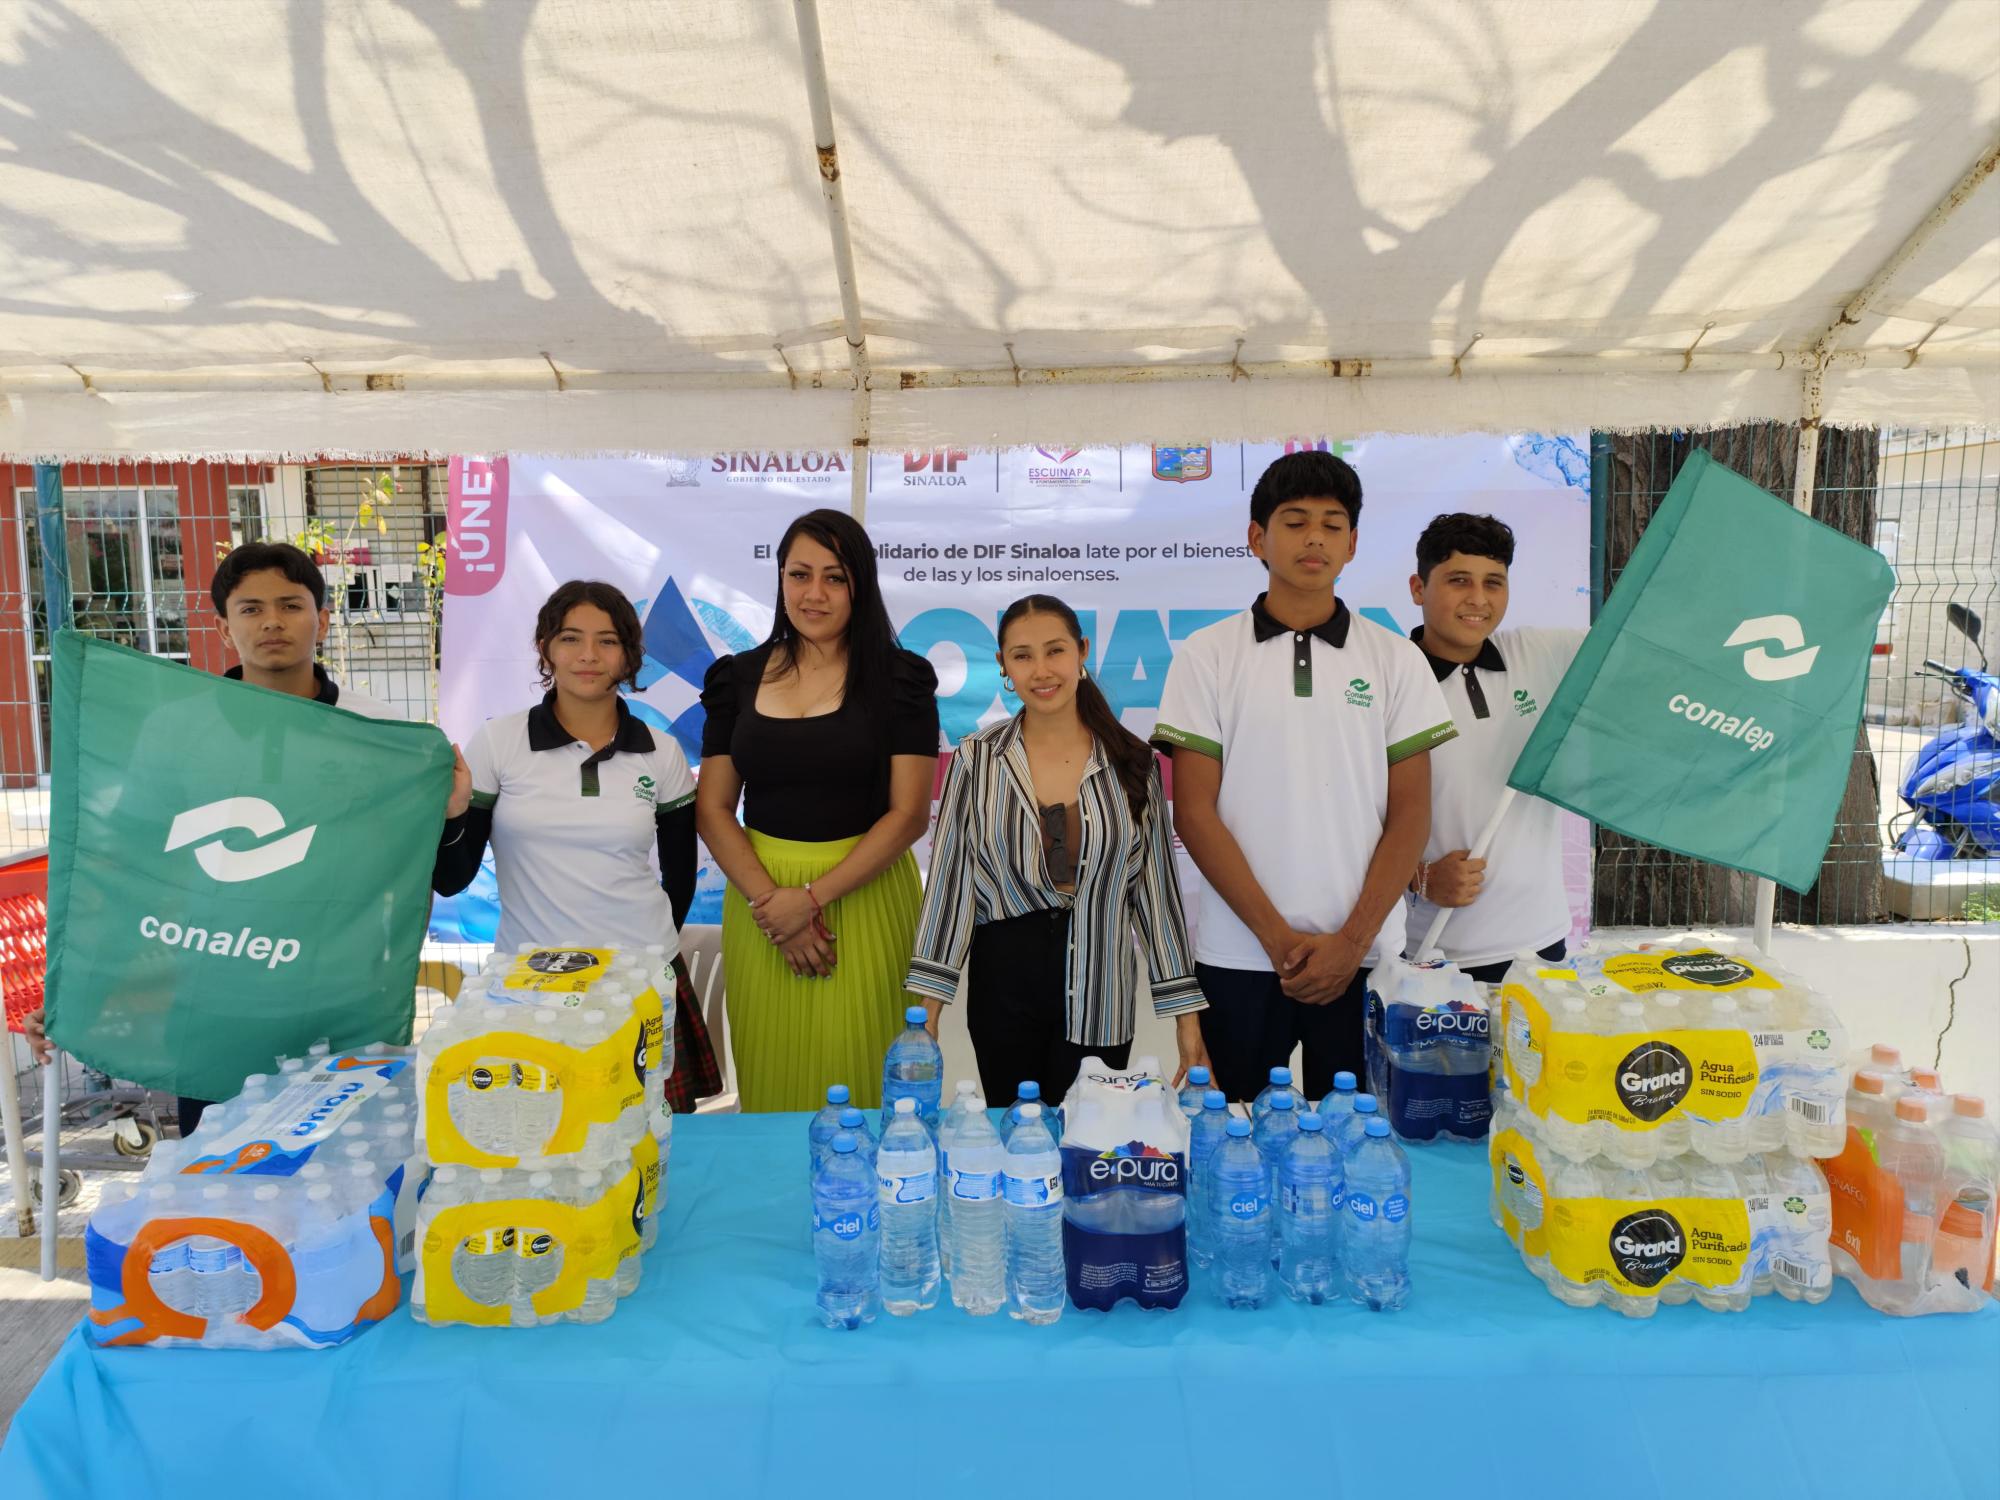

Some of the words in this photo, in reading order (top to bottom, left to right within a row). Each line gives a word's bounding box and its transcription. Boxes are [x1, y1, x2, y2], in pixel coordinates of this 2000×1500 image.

[711, 451, 846, 473] SINALOA
[903, 475, 967, 487] SINALOA
[1028, 468, 1091, 477] ESCUINAPA
[451, 455, 496, 572] ¡ÚNET
[754, 545, 771, 559] El
[944, 543, 968, 559] de
[974, 544, 1006, 559] DIF
[1011, 543, 1080, 559] Sinaloa
[1086, 543, 1122, 559] late
[1126, 547, 1157, 562] por
[1162, 543, 1178, 559] el
[1183, 543, 1253, 559] bienest
[903, 567, 927, 582] de
[932, 567, 957, 582] las
[961, 570, 973, 585] y
[978, 567, 1003, 582] los
[1007, 566, 1119, 582] sinaloenses.
[1668, 694, 1774, 752] conalep
[140, 916, 300, 969] conalep
[1700, 1060, 1735, 1074] Agua
[1620, 1068, 1686, 1092] Grand
[1700, 1071, 1755, 1085] Purificada
[1629, 1088, 1677, 1107] Brand
[1700, 1088, 1715, 1096] SIN
[1716, 1089, 1742, 1098] SODIO
[1232, 1198, 1258, 1213] ciel
[1351, 1199, 1374, 1216] ciel
[834, 1217, 860, 1234] ciel
[1690, 1228, 1723, 1241] Agua
[1614, 1236, 1681, 1257] Grand
[1692, 1239, 1747, 1253] Purificada
[1622, 1257, 1671, 1271] Brand
[1692, 1256, 1705, 1265] SIN
[1706, 1257, 1733, 1266] SODIO
